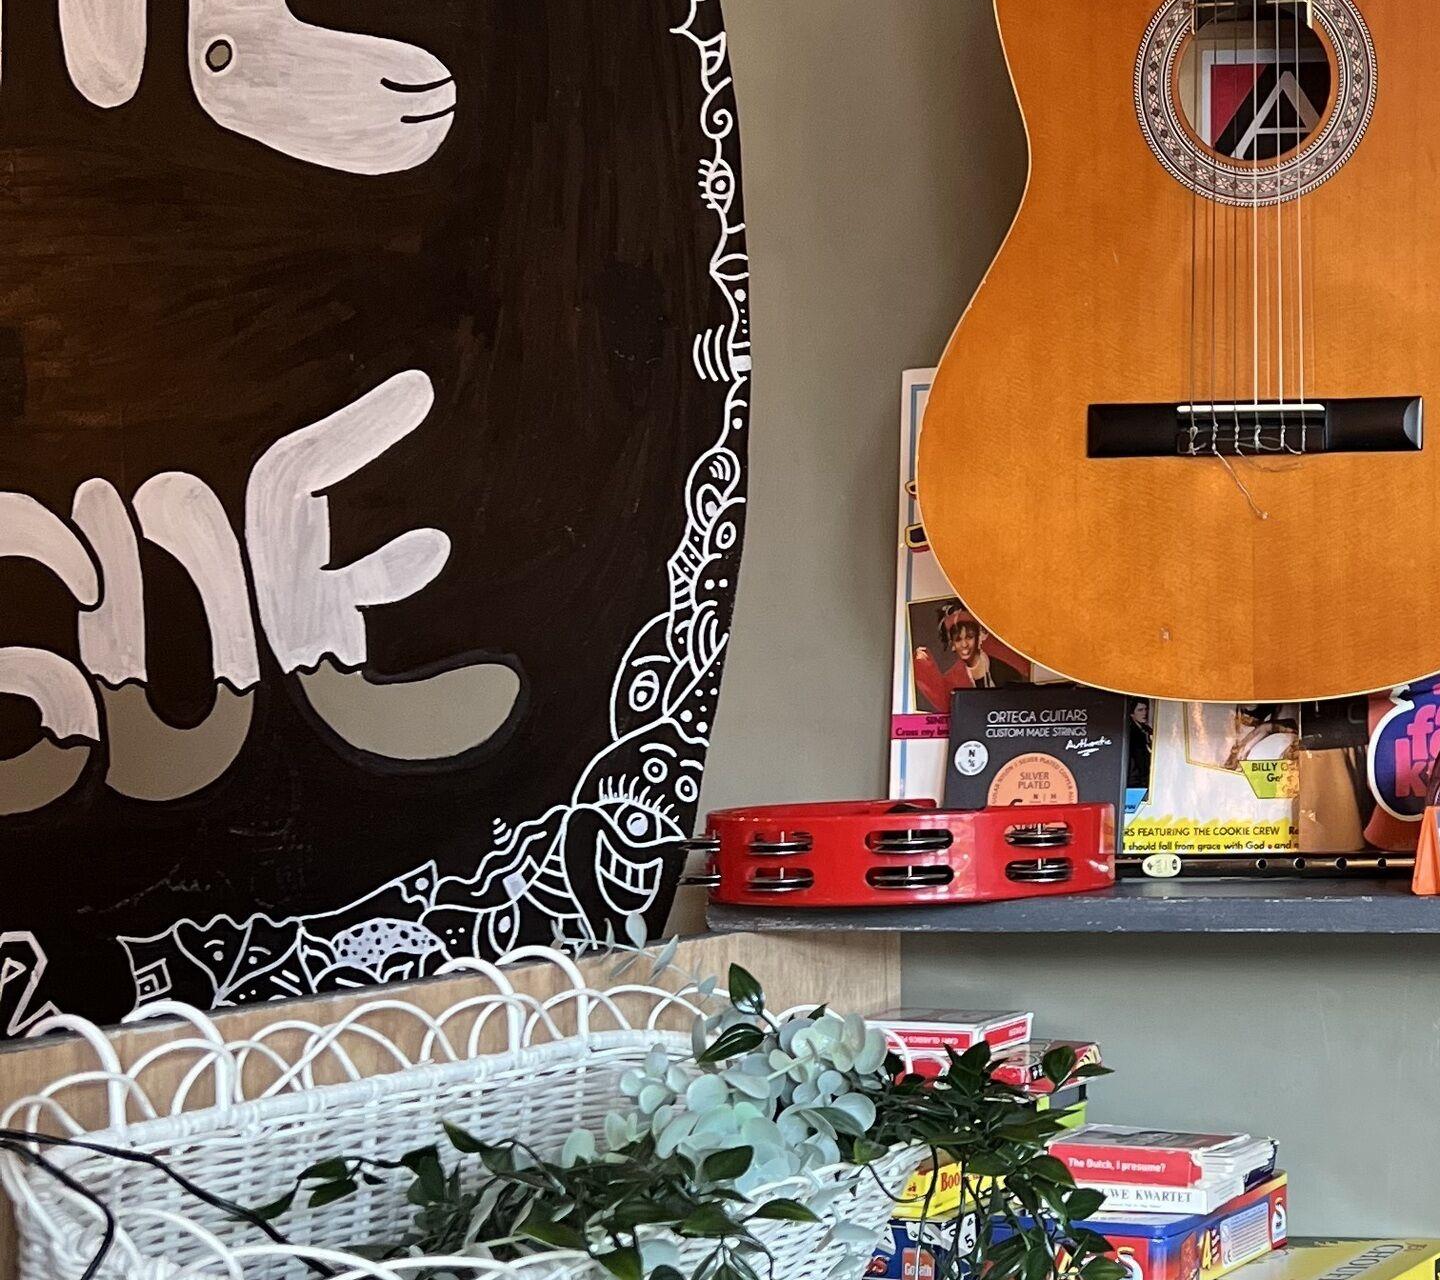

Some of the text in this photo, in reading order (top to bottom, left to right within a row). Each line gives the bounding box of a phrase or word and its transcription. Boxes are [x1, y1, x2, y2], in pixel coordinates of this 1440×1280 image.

[987, 709, 1088, 724] ORTEGA GUITARS
[985, 726, 1088, 738] CUSTOM MADE STRINGS
[1252, 762, 1278, 772] BILLY
[1020, 771, 1050, 780] SILVER
[1017, 780, 1051, 790] PLATED
[1138, 827, 1190, 837] FEATURING
[1194, 827, 1211, 837] THE
[1213, 827, 1250, 837] COOKIE
[1252, 826, 1280, 837] CREW
[1128, 841, 1156, 851] should
[1175, 841, 1195, 851] from
[1197, 843, 1221, 853] grace
[1223, 841, 1243, 850] with
[1245, 841, 1265, 850] God
[1068, 1157, 1085, 1168] The
[1122, 1160, 1167, 1174] presume?
[1135, 1190, 1193, 1203] KWARTET
